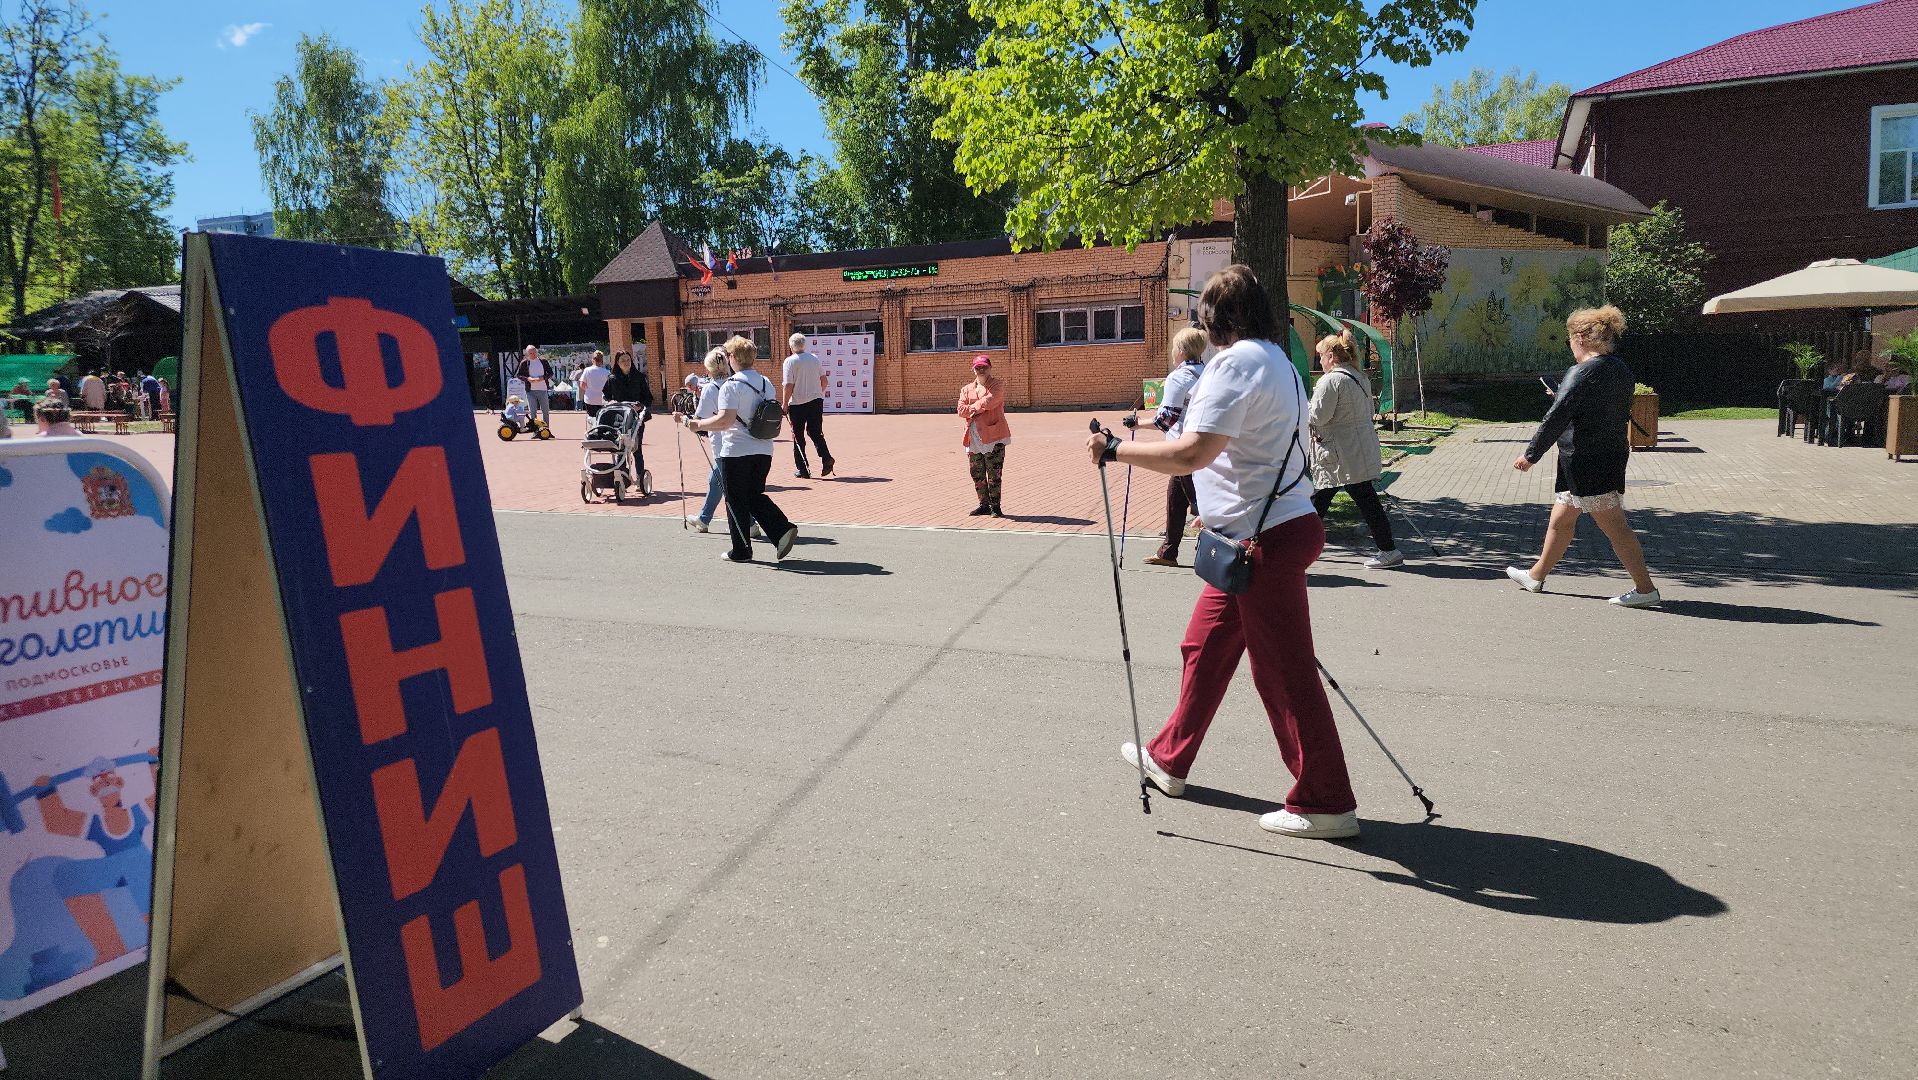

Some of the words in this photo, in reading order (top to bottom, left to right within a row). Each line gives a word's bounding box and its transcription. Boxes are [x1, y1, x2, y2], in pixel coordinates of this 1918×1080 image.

[0, 610, 167, 666] голети
[6, 656, 129, 691] ПОДМОСКОВЬЕ
[269, 297, 541, 1050] ФИНИШ
